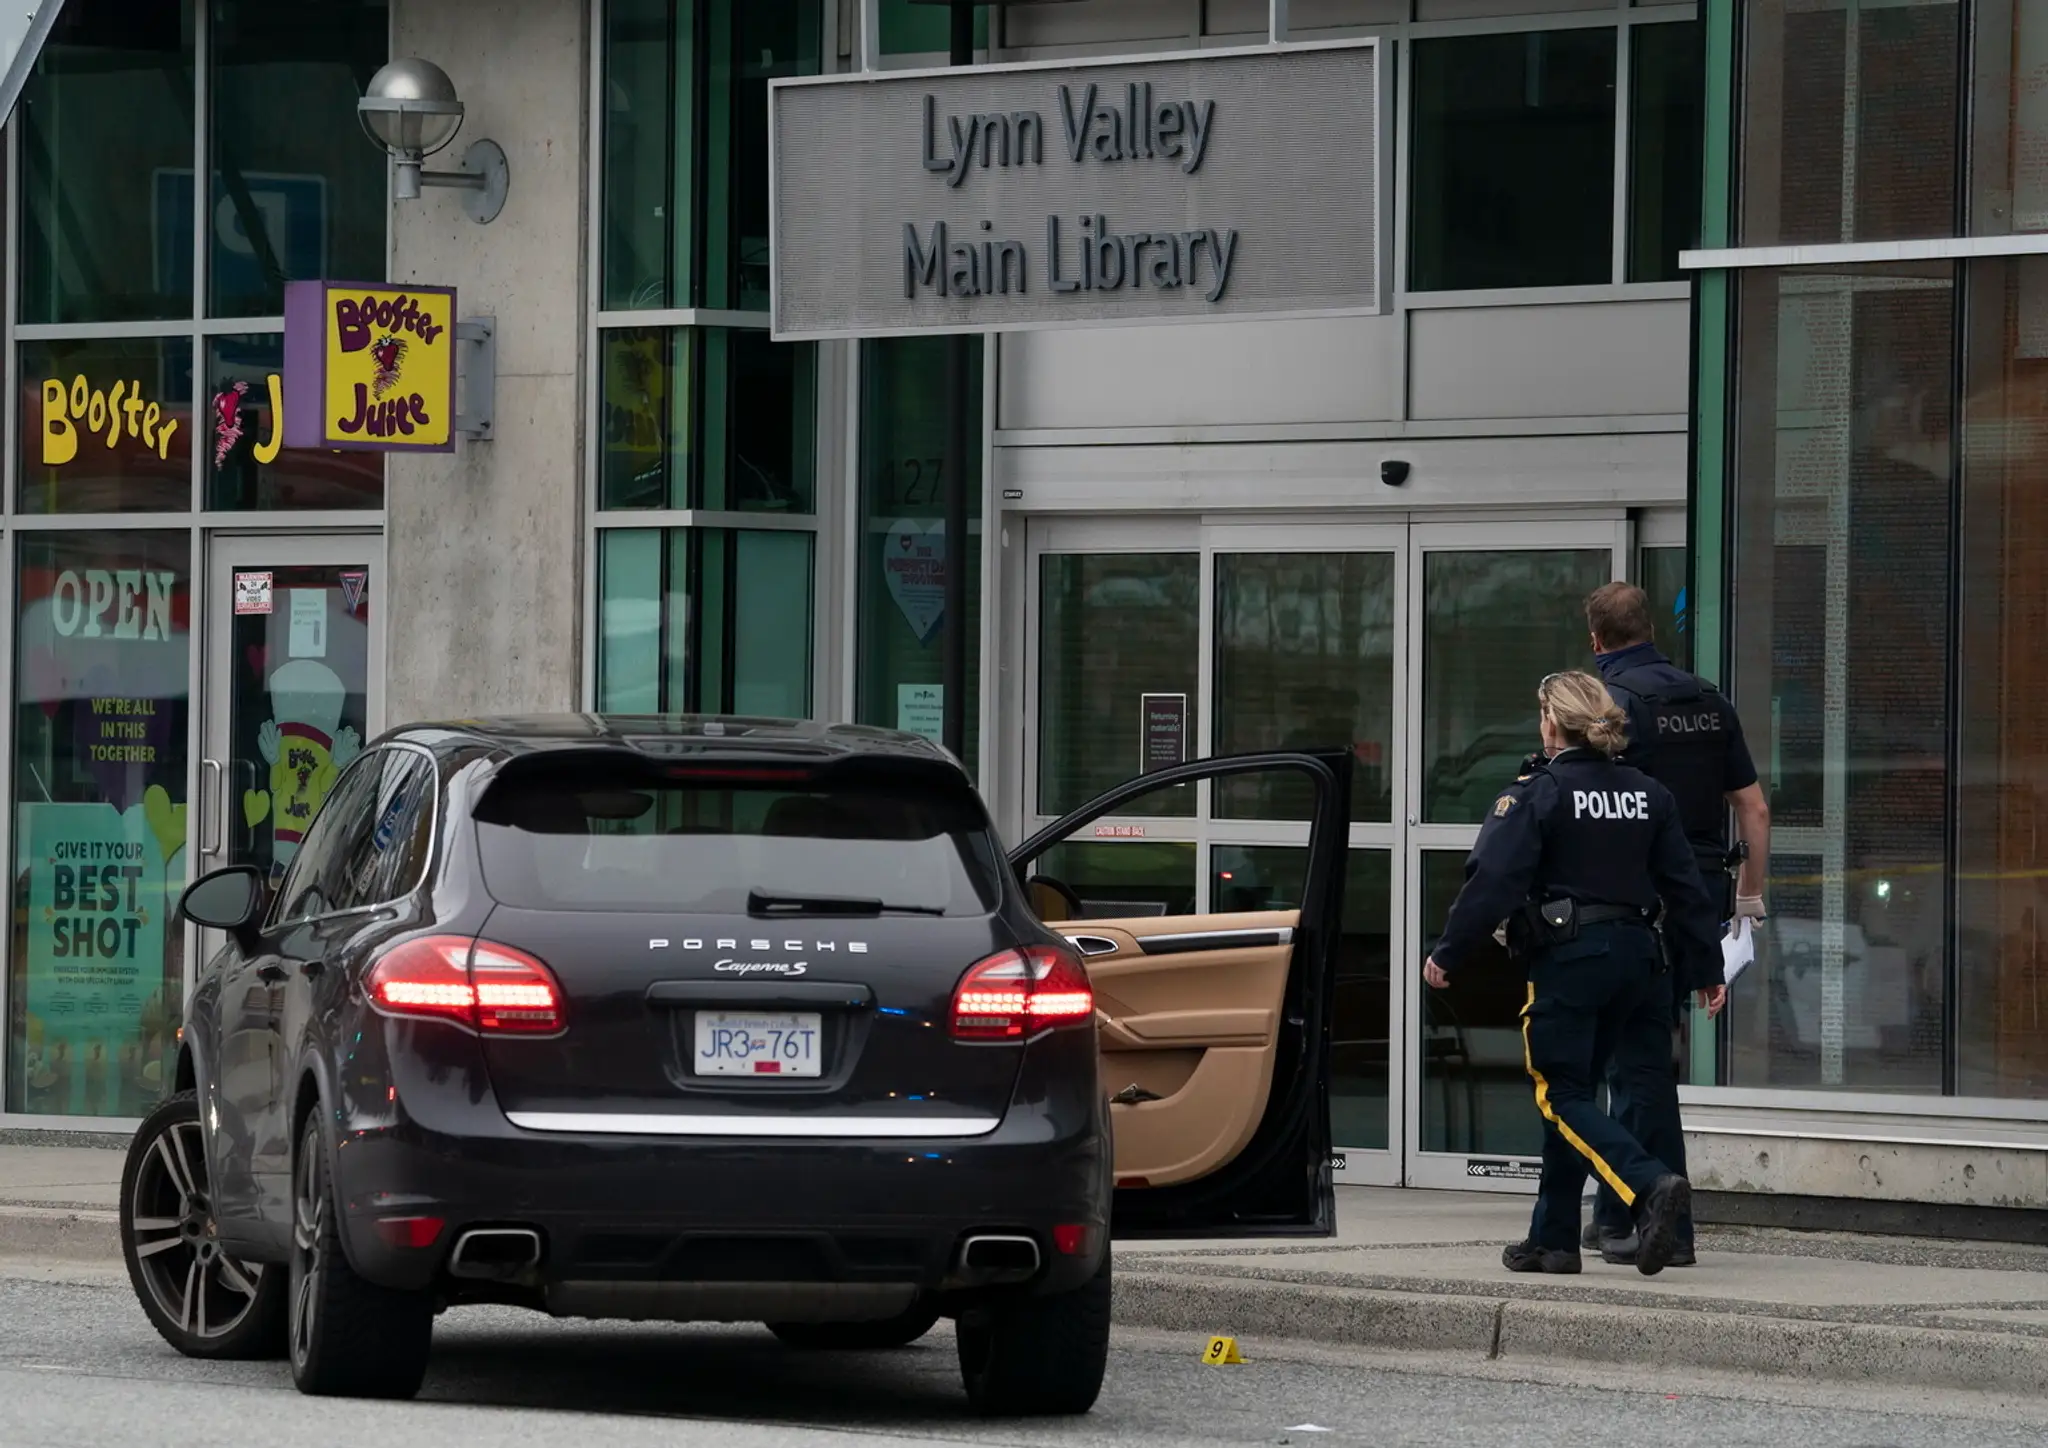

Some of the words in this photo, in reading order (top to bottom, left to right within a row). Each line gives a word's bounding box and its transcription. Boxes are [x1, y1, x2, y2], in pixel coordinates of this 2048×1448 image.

[922, 94, 1043, 187] Lynn
[1057, 81, 1215, 174] Valley
[903, 220, 1026, 298] Main
[1046, 213, 1239, 302] Library
[336, 294, 443, 353] Booster
[42, 373, 178, 465] Booster
[337, 382, 430, 437] Juice
[52, 569, 175, 642] OPEN
[91, 697, 131, 715] WE'RE
[133, 699, 156, 716] ALL
[101, 721, 115, 739] IN
[117, 721, 146, 739] THIS
[1657, 712, 1721, 734] POLICE
[90, 744, 156, 762] TOGETHER
[1573, 790, 1649, 820] POLICE
[55, 841, 87, 859] GIVE
[90, 841, 103, 859] IT
[105, 842, 143, 860] YOUR
[54, 864, 143, 912] BEST
[53, 916, 142, 958] SHOT
[649, 938, 869, 954] PORSCHE
[714, 958, 789, 977] Cayenne
[784, 961, 808, 976] S
[701, 1029, 750, 1058] JR3
[767, 1030, 815, 1059] 76T
[1210, 1340, 1223, 1359] 9
